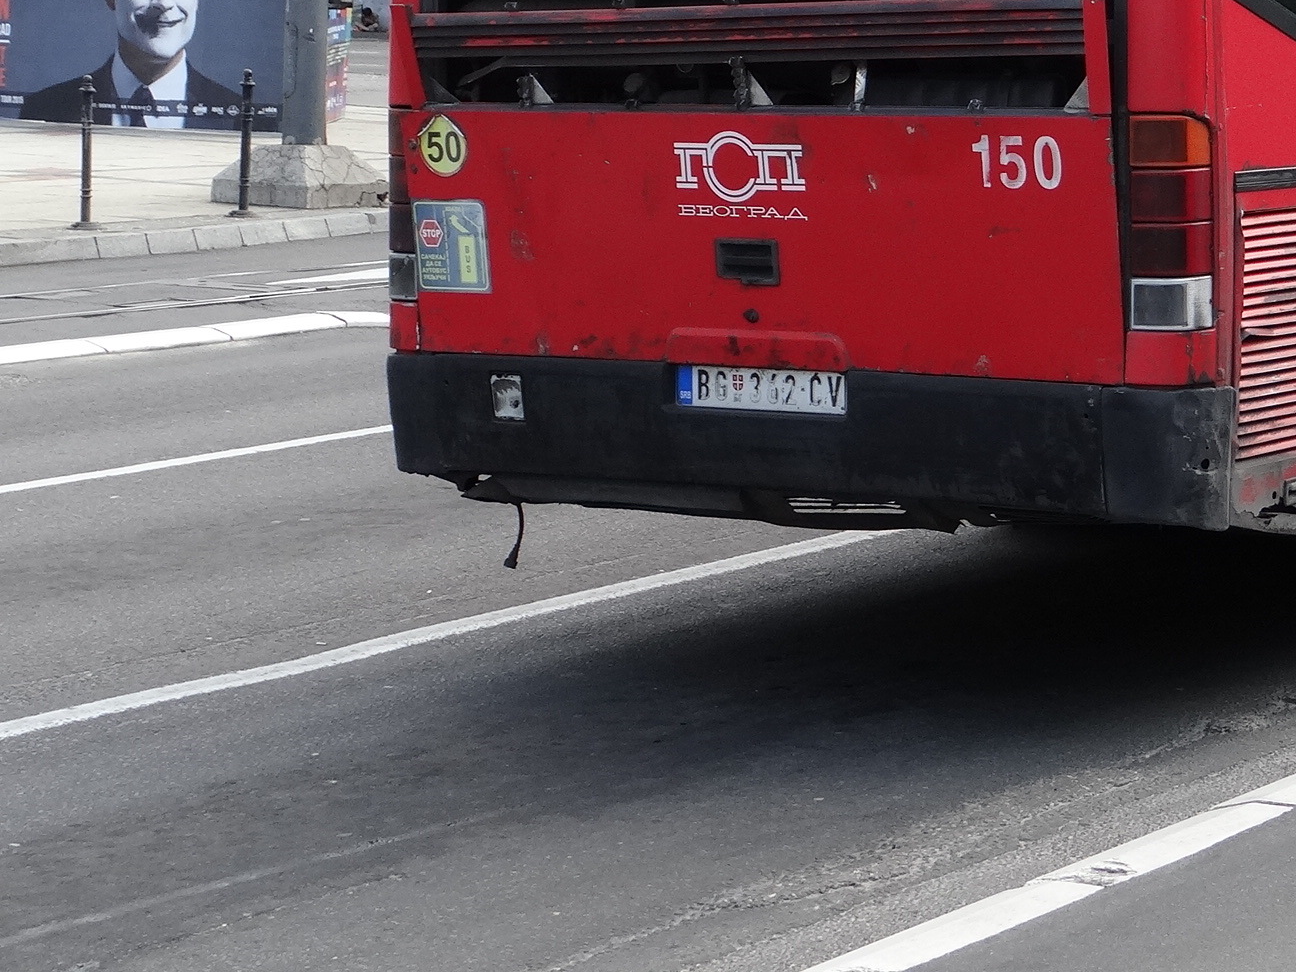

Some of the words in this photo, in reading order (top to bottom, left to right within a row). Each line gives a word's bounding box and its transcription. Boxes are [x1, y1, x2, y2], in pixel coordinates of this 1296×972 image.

[427, 131, 462, 164] 50
[971, 134, 1062, 190] 150
[673, 130, 806, 203] ГСП
[677, 204, 808, 221] БЕОГРАД
[422, 229, 442, 239] STOP
[464, 245, 472, 274] BUS
[680, 390, 692, 400] SRB
[697, 369, 728, 402] BG
